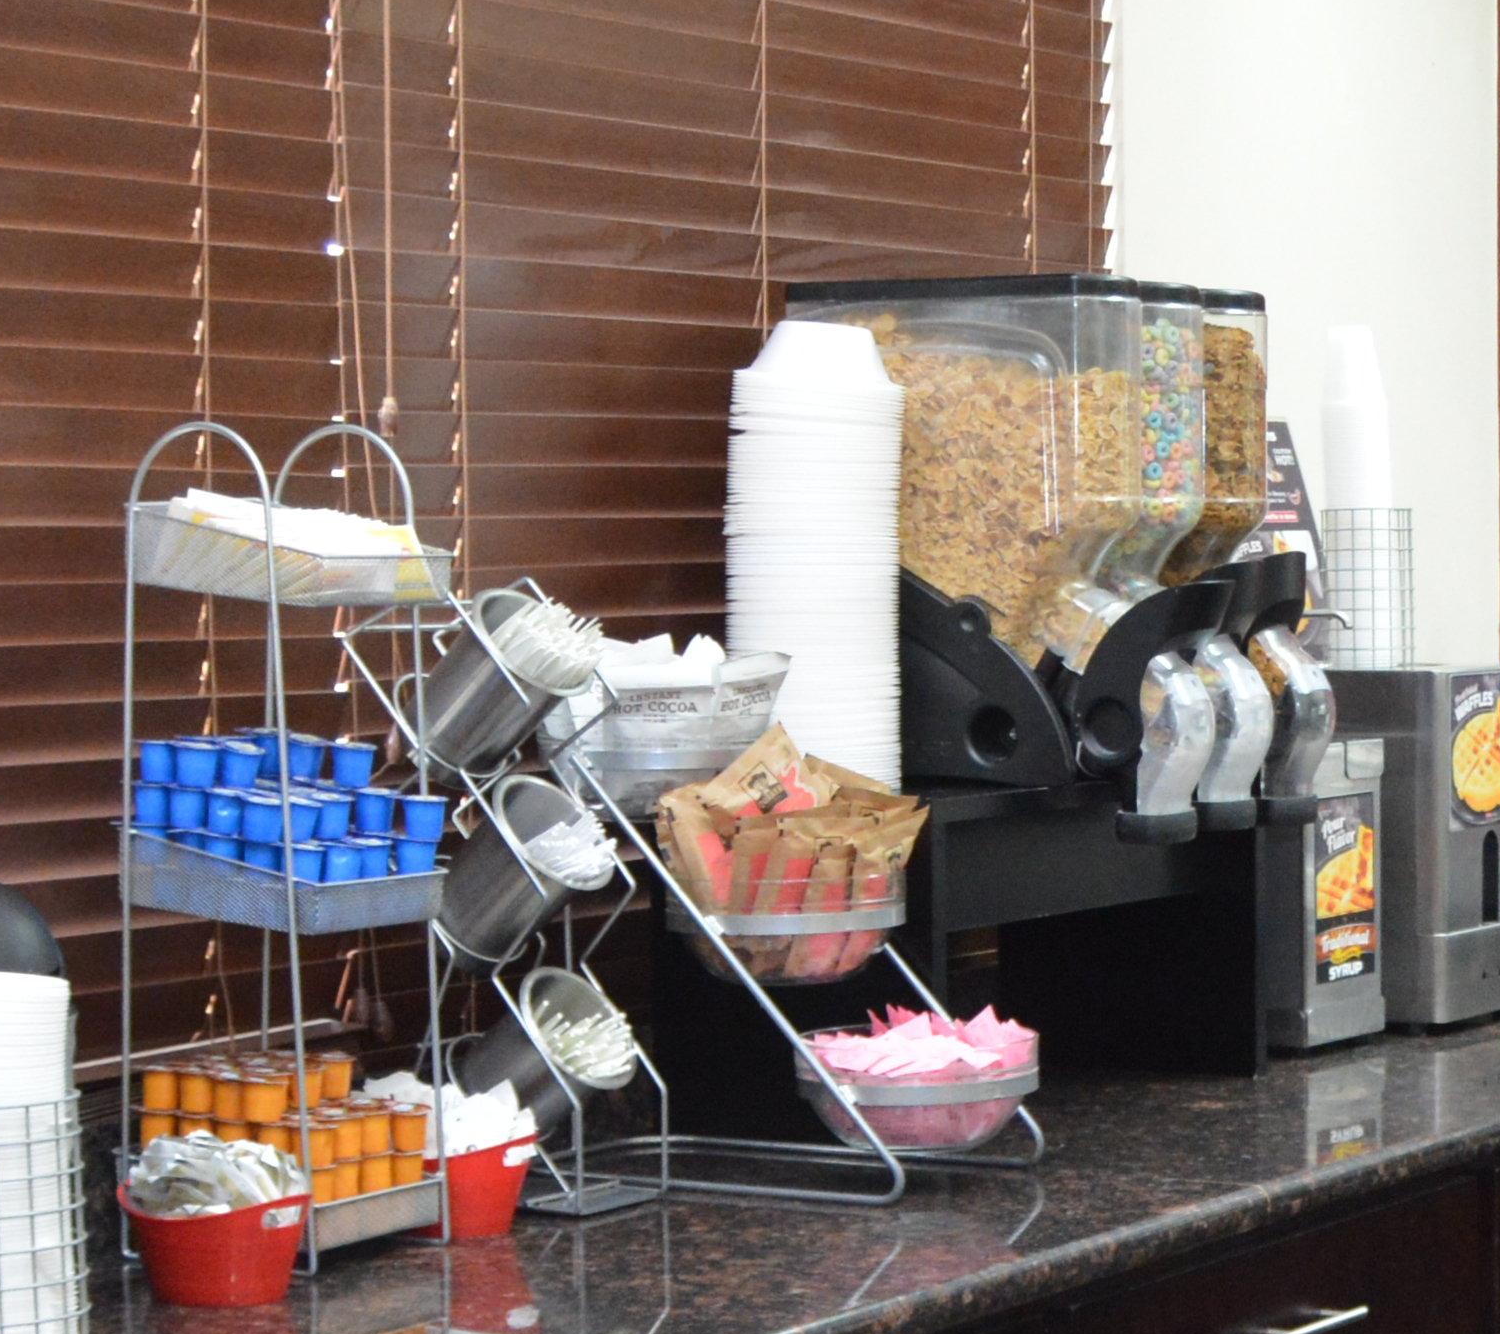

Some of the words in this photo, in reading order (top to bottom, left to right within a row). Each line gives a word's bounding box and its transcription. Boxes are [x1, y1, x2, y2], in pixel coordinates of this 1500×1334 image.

[613, 703, 642, 714] HOT
[649, 701, 698, 714] COCOA
[720, 698, 740, 712] HOT
[1328, 961, 1364, 981] SYRUP
